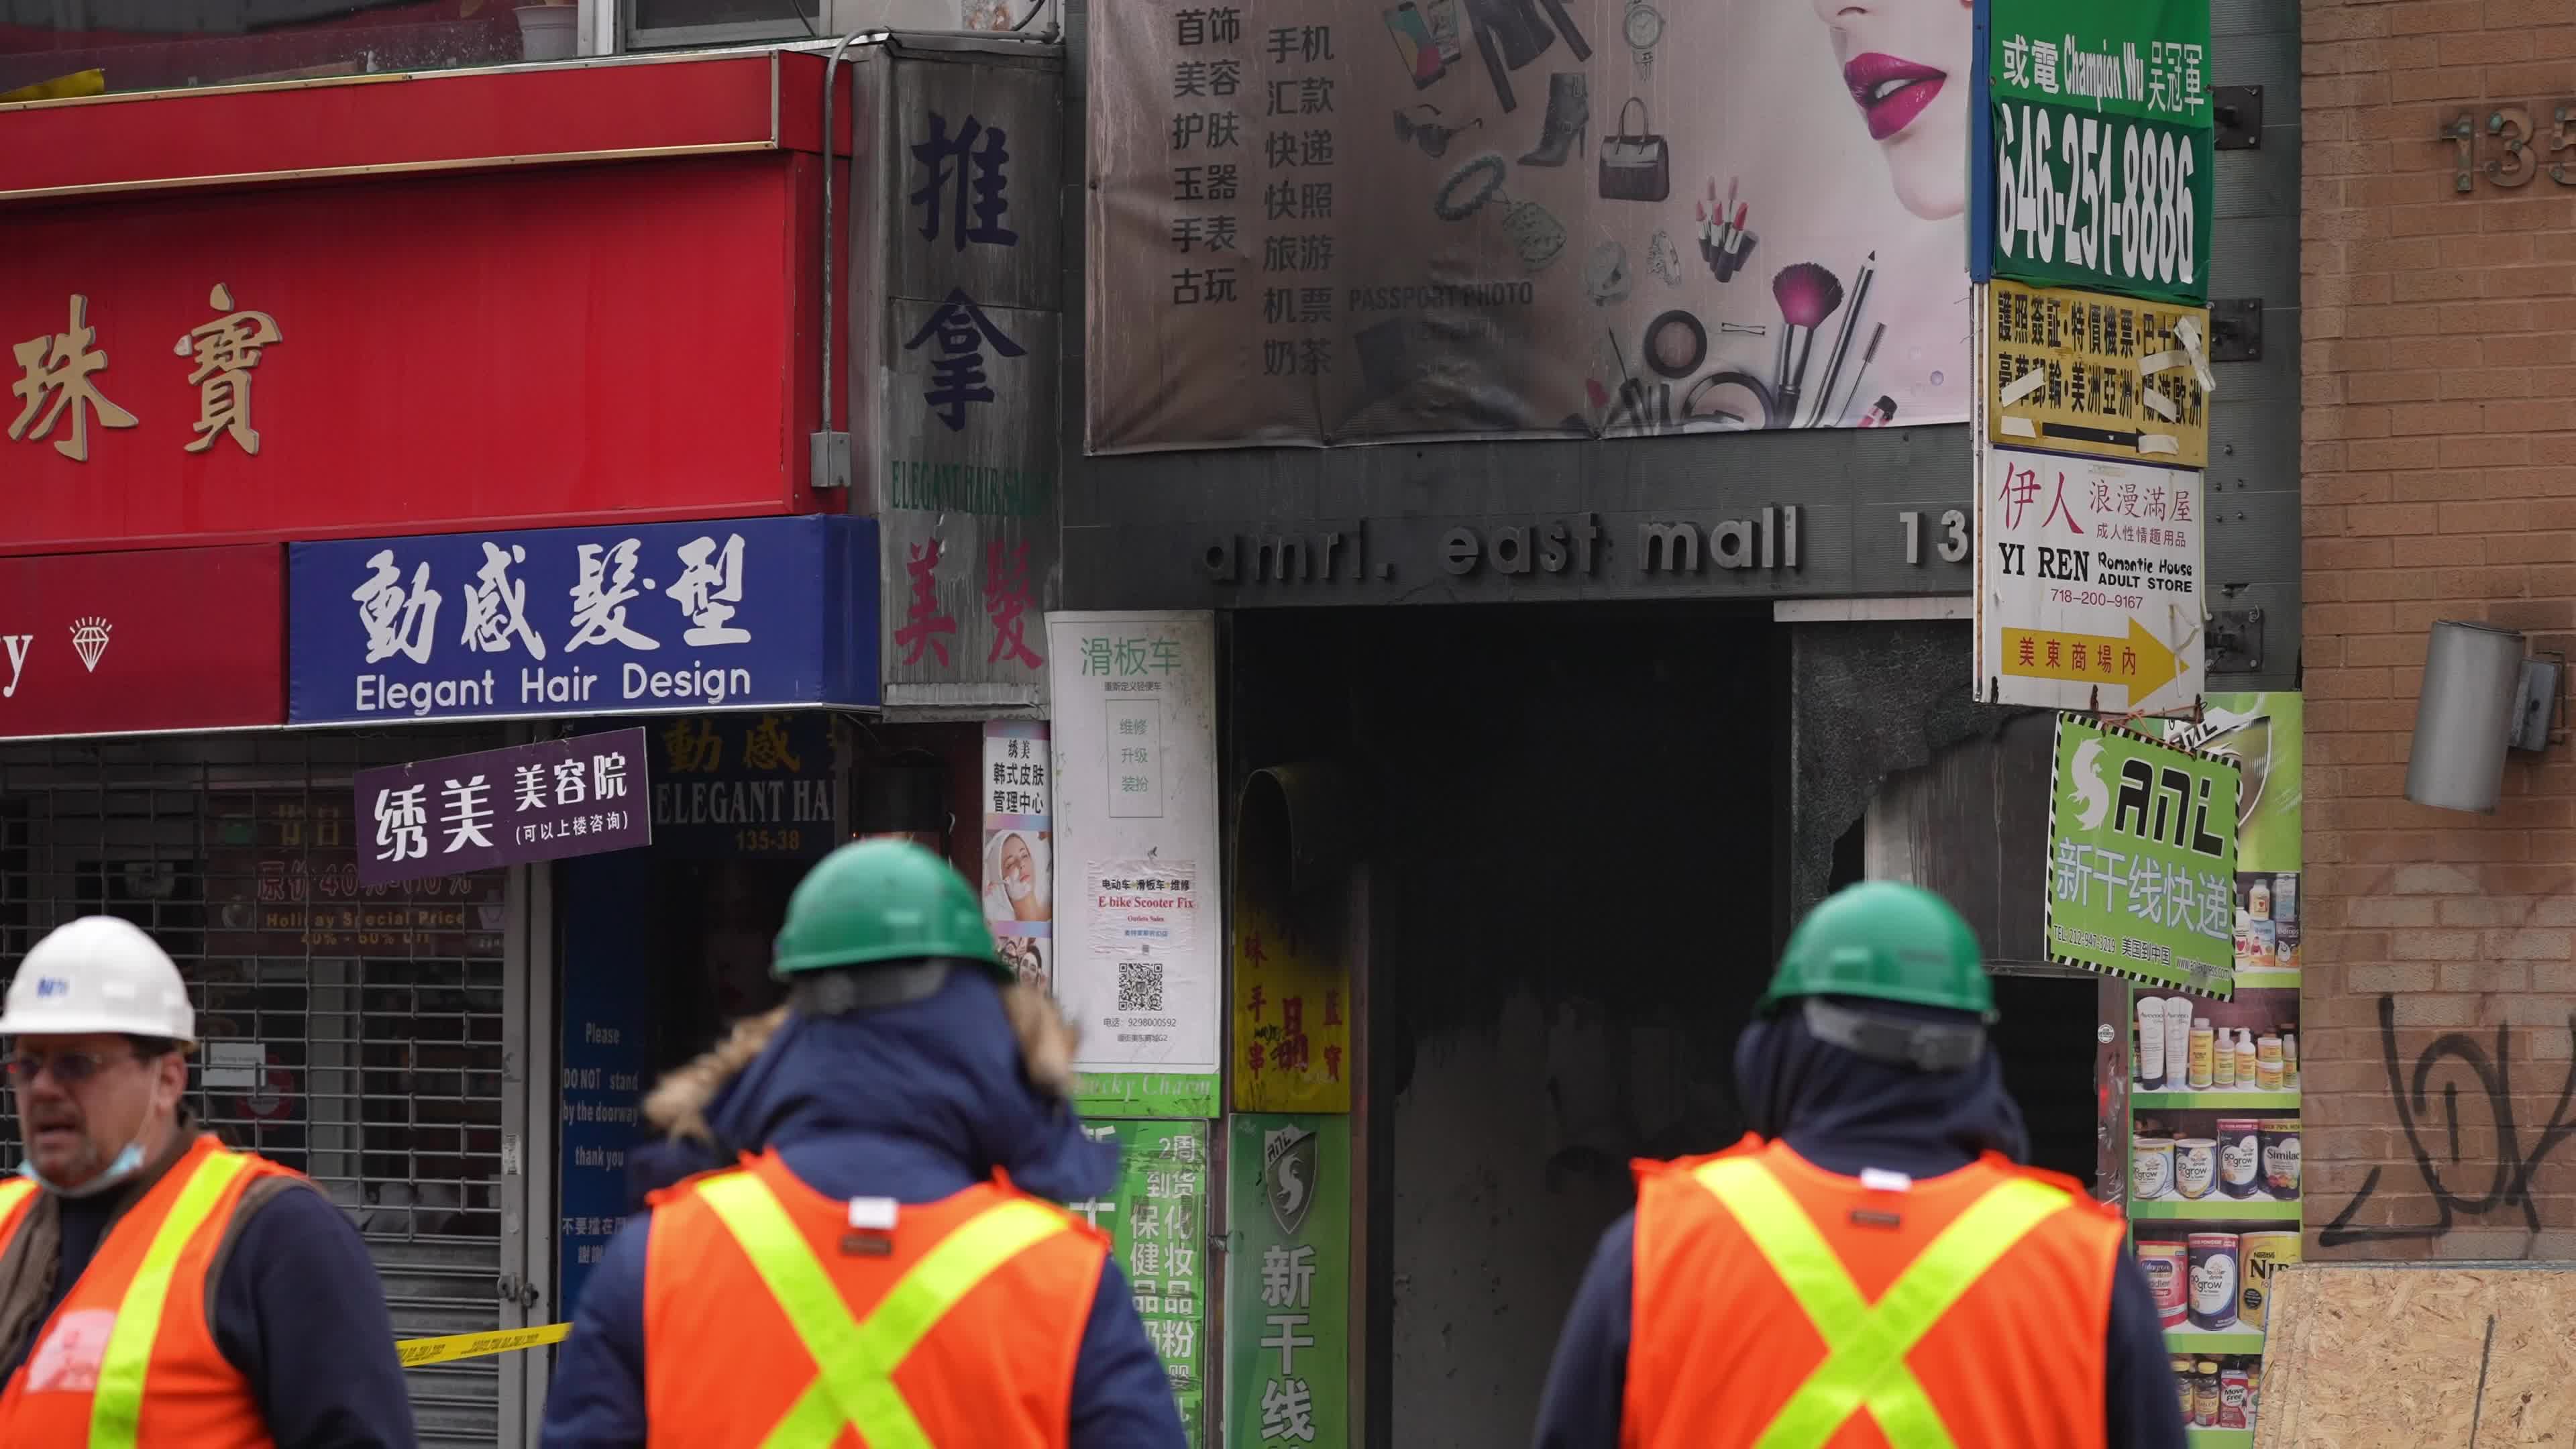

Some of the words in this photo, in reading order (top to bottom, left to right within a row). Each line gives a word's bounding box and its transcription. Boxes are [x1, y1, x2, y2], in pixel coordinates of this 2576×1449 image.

[1175, 7, 1240, 46] 首饰
[1266, 25, 1334, 64] 手机
[1175, 60, 1240, 98] 美容
[2002, 34, 2059, 95] 或電
[2064, 34, 2123, 113] Champion
[2123, 42, 2144, 102] Wu
[1266, 77, 1334, 116] 汇款
[1173, 112, 1240, 150] 护肤
[1265, 130, 1334, 168] 快递
[1174, 164, 1238, 202] 玉器
[1264, 180, 1332, 221] 快照
[1999, 103, 2194, 284] 646-251-8886
[1171, 215, 1236, 254] 手表
[1263, 235, 1334, 272] 旅游
[905, 110, 1028, 433] 推拿
[1172, 268, 1238, 305] 古玩
[1264, 286, 1332, 324] 机票
[1349, 285, 1460, 312] PASSPORT
[1462, 282, 1534, 308] PHOTO
[8, 282, 283, 462] 珠寶
[1263, 338, 1332, 377] 奶茶
[1998, 462, 2084, 534] 伊人
[2089, 478, 2193, 523] 浪漫滿屋
[1442, 513, 1603, 577] east
[1638, 504, 1805, 572] mall
[2096, 523, 2186, 548] 成人性情趣用品
[1998, 542, 2025, 576] YI
[2038, 546, 2090, 582] REN
[2098, 551, 2153, 574] Romantic
[2159, 559, 2192, 577] House
[2050, 588, 2143, 609] 718-200-9167
[2098, 573, 2141, 588] ADULT
[2147, 577, 2193, 593] STORE
[1080, 637, 1182, 677] 滑板车
[356, 669, 494, 716] Elegant
[521, 664, 598, 704] Hair
[623, 660, 751, 705] Design
[1119, 718, 1149, 736] 维修
[994, 763, 1044, 786] 韩式皮肤
[1121, 747, 1149, 764] 升级
[654, 780, 785, 826] ELEGANT
[994, 790, 1044, 814] 管理中心
[1121, 774, 1149, 794] 装扮
[374, 774, 494, 863] 绣美
[514, 750, 628, 812] 美容院
[1134, 896, 1174, 908] Scooter
[1177, 897, 1193, 908] Fix
[2055, 837, 2231, 941] 新干线快递
[2122, 936, 2171, 967] 美国到中国
[586, 1022, 621, 1045] Please
[563, 1069, 580, 1089] DO
[581, 1069, 602, 1089] NOT
[608, 1071, 639, 1091] stand
[563, 1100, 575, 1126] by
[577, 1102, 594, 1121] the
[595, 1102, 639, 1127] doorway
[574, 1146, 604, 1166] thank
[605, 1150, 624, 1172] you
[1159, 1135, 1195, 1163] 2周
[2267, 1148, 2300, 1161] Similac
[1147, 1170, 1196, 1199] 到货
[1130, 1203, 1160, 1313] 保健品
[1163, 1205, 1195, 1316] 化妆品
[2197, 1279, 2222, 1292] grow
[1261, 1244, 1316, 1449] 新干线
